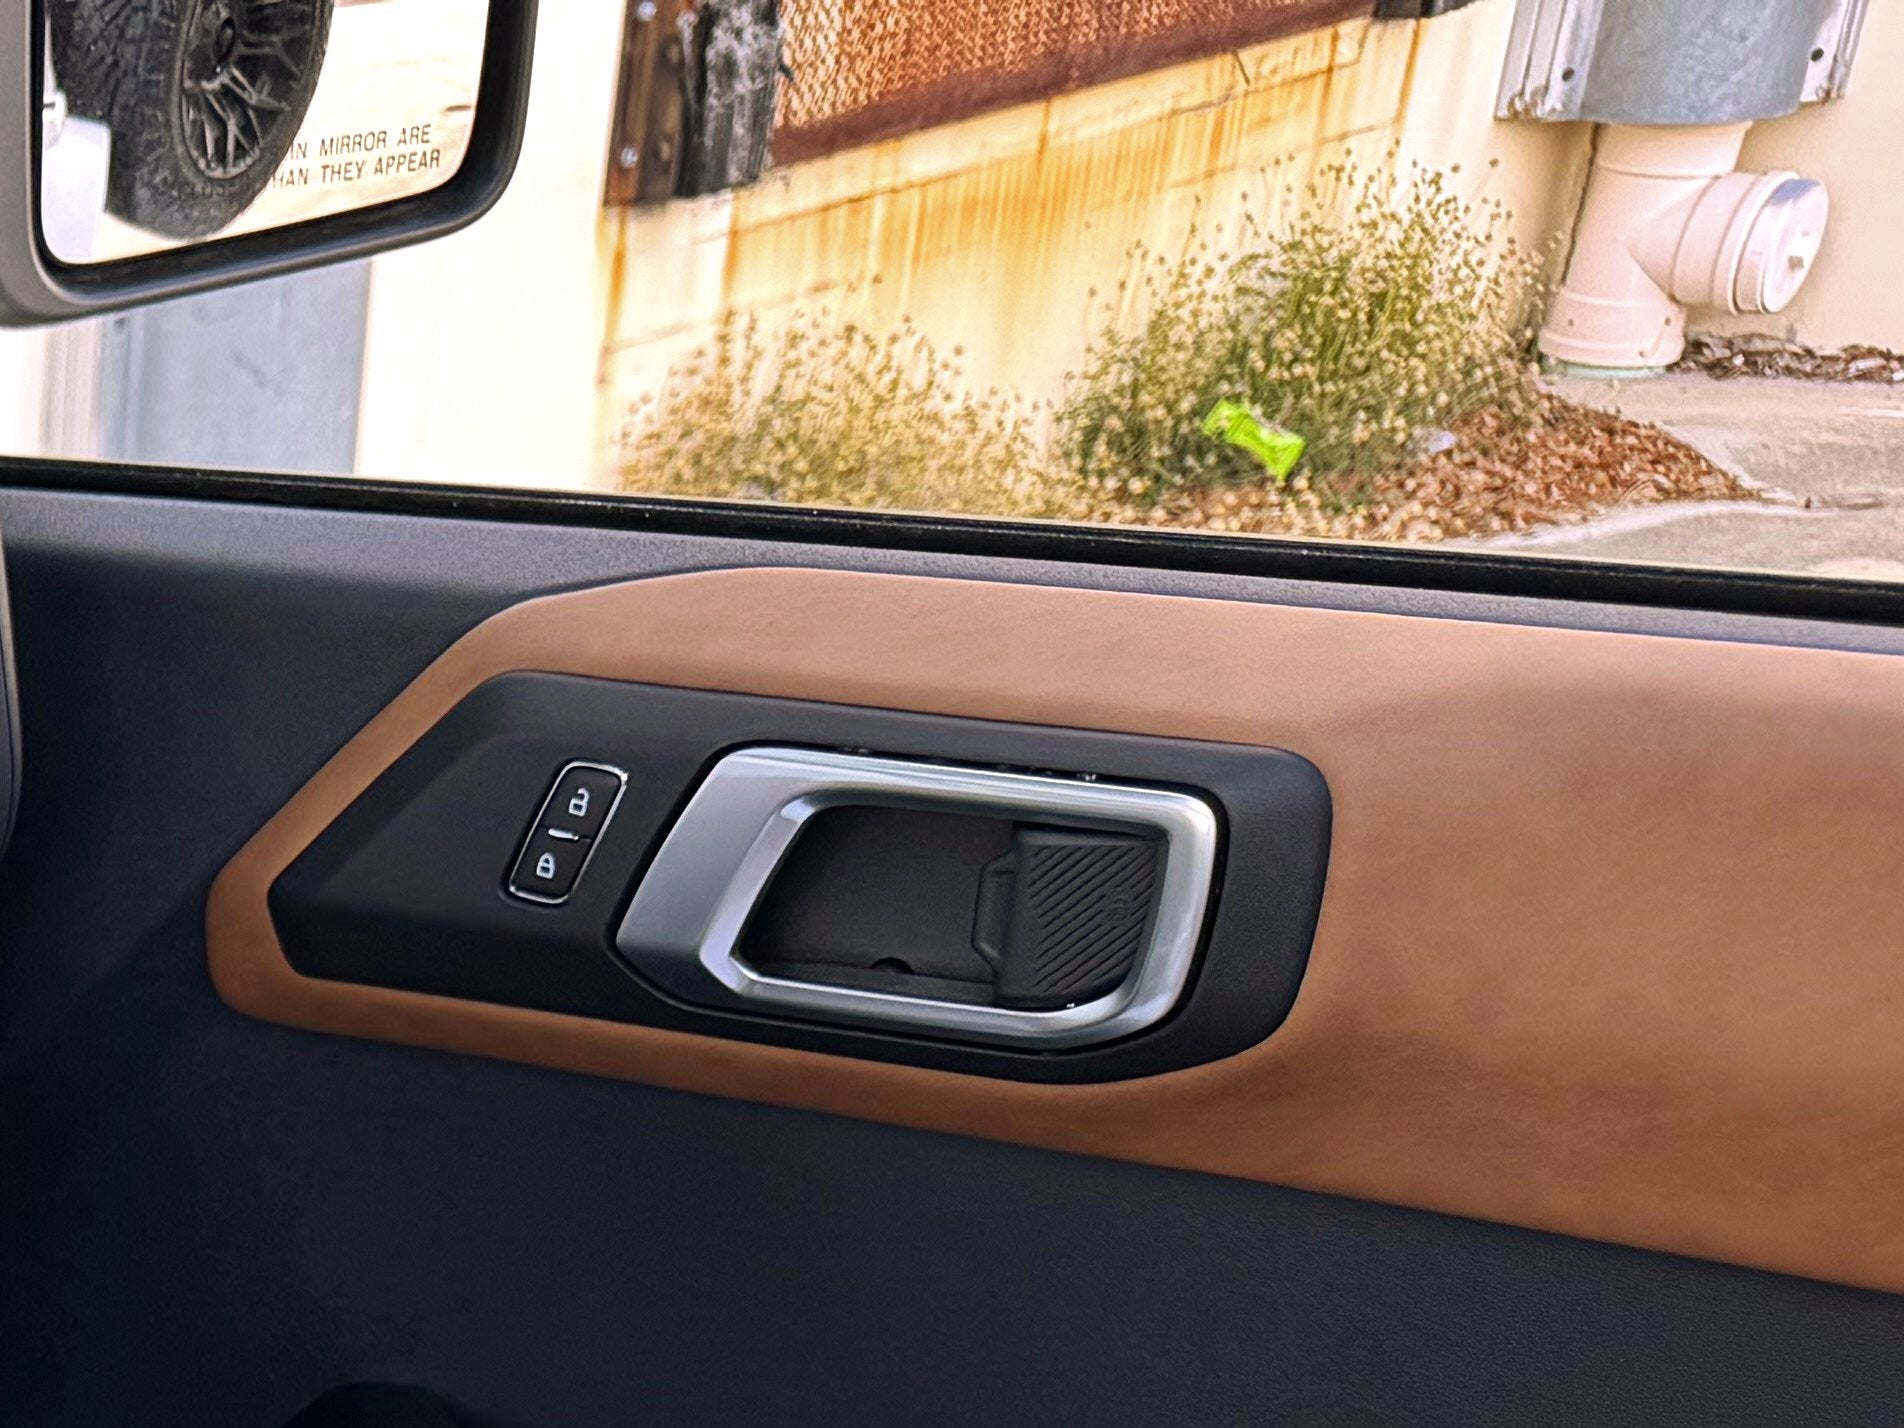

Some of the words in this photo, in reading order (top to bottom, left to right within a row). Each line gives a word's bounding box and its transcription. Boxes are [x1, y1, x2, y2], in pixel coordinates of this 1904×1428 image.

[319, 130, 387, 157] MIRROR
[397, 123, 432, 147] ARE
[271, 168, 309, 190] HAN
[322, 160, 366, 183] THEY
[374, 148, 440, 176] APPEAR
